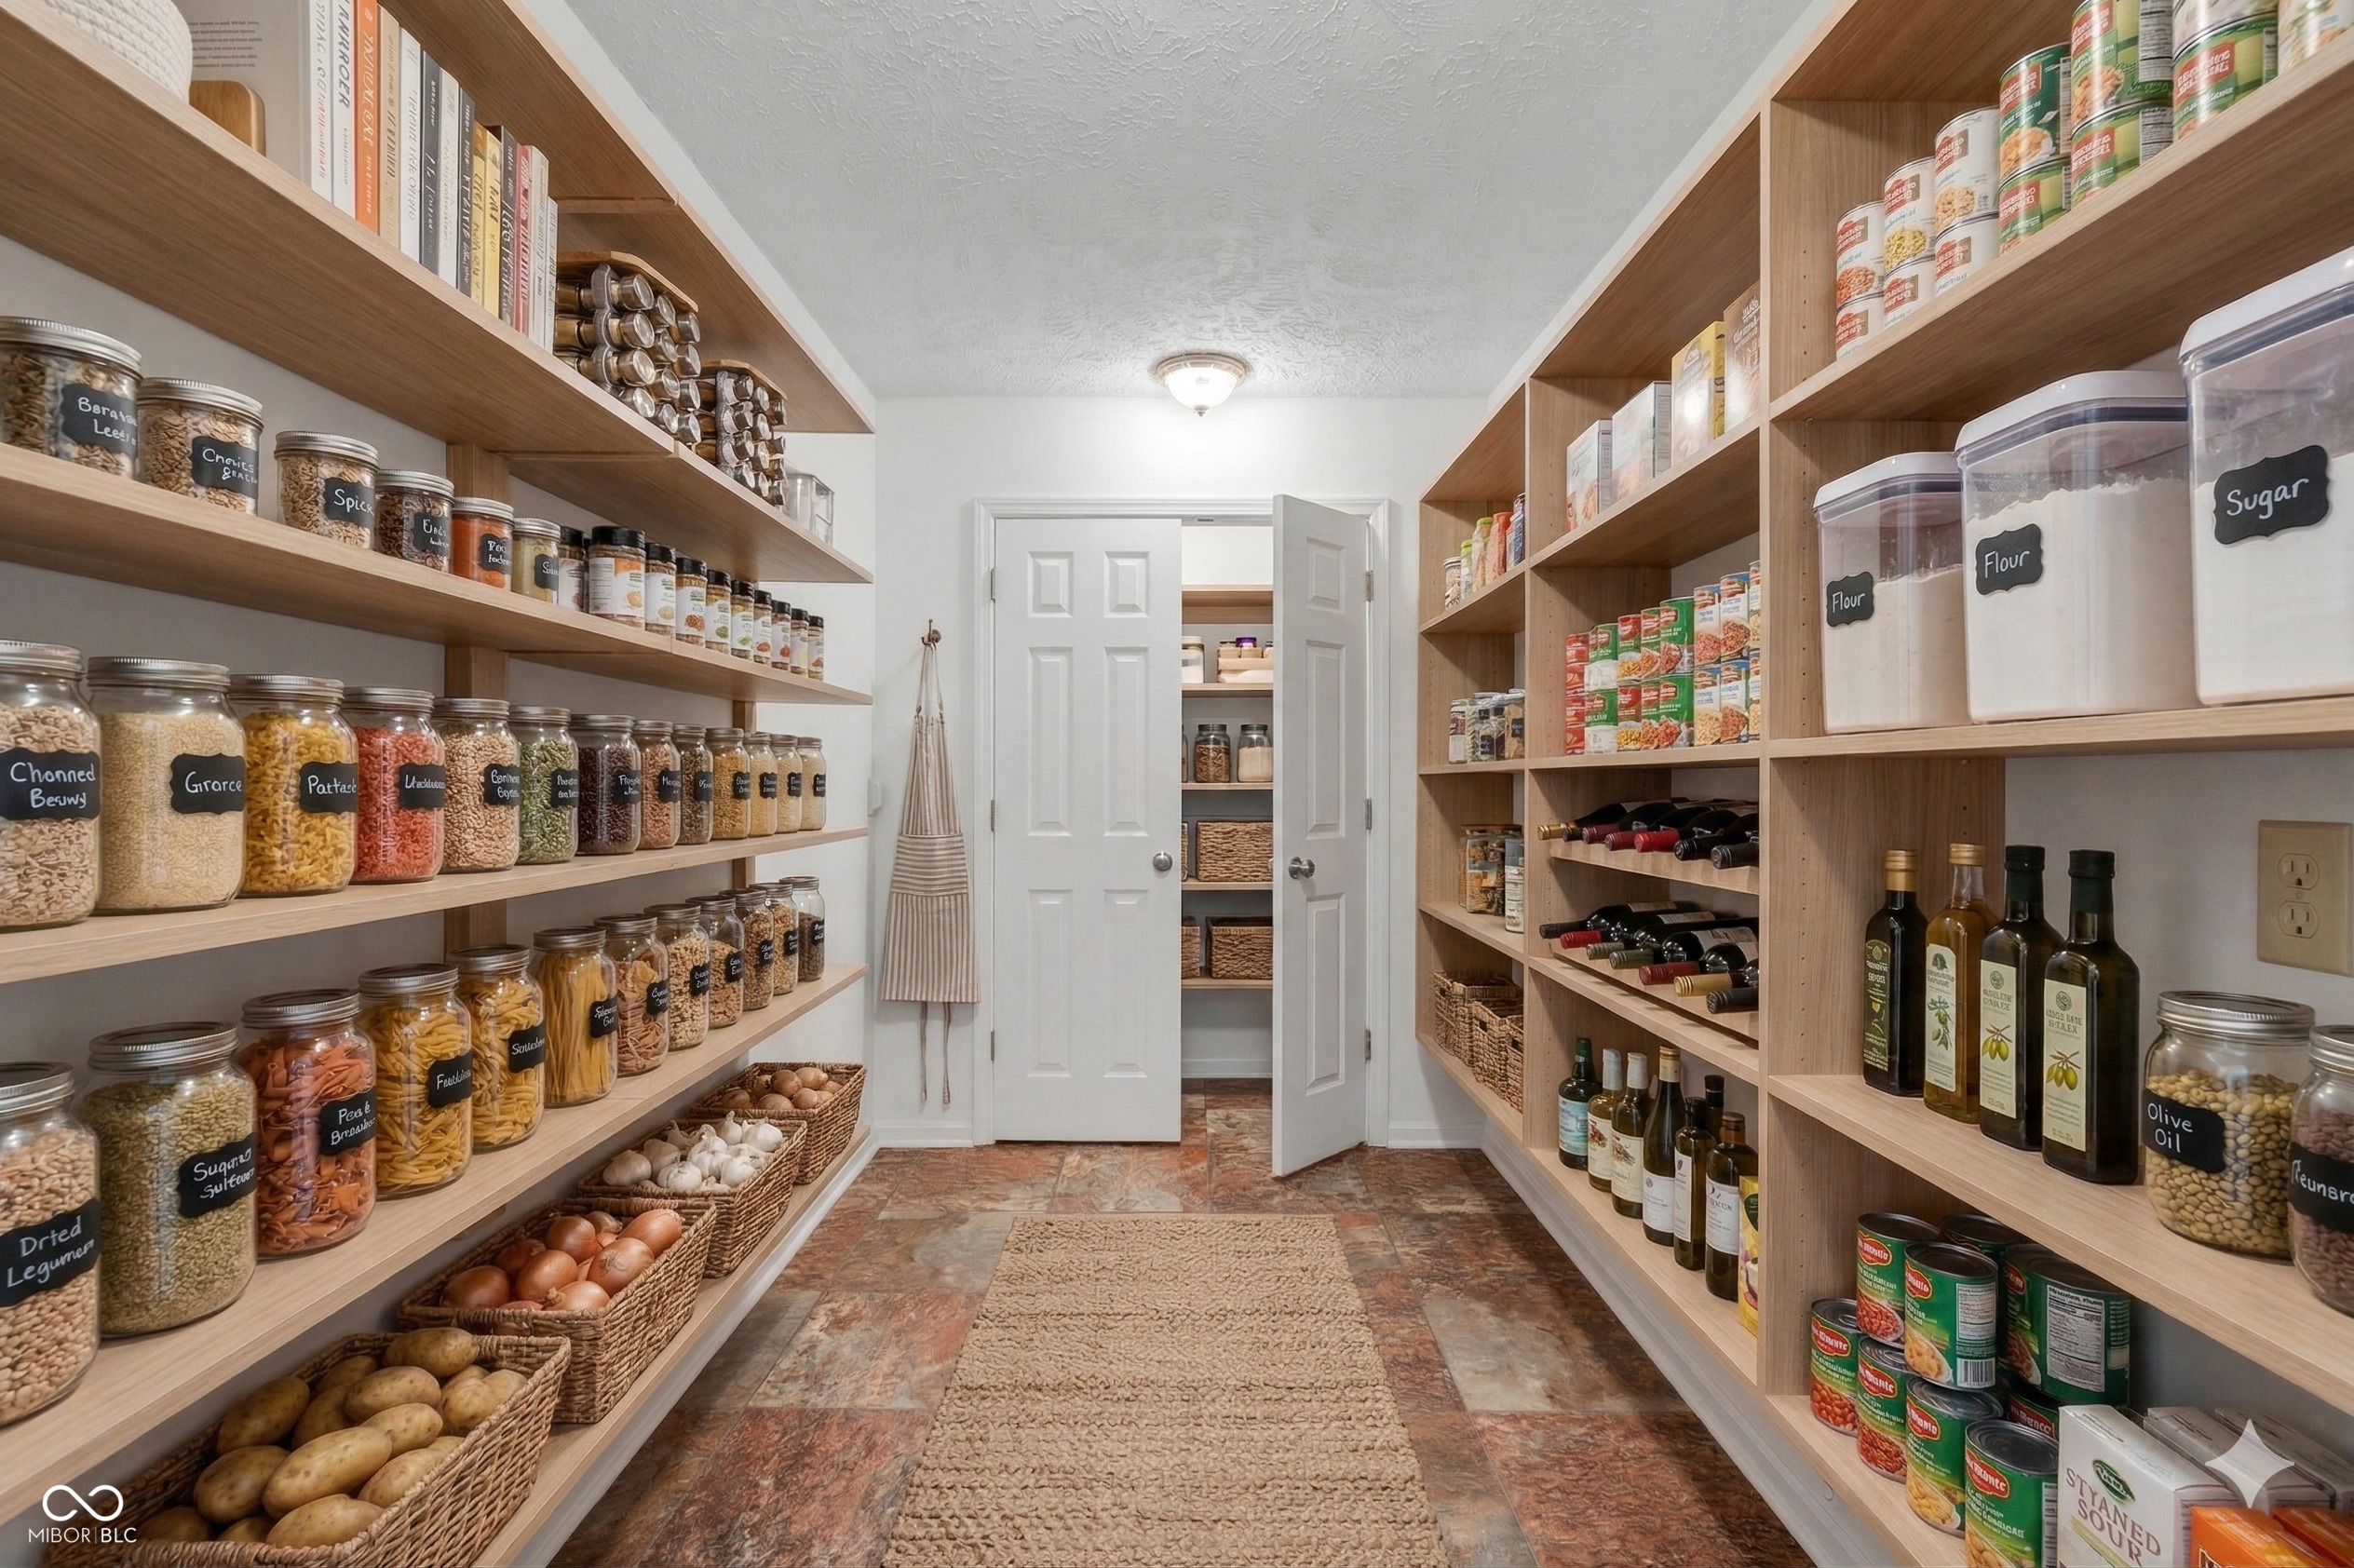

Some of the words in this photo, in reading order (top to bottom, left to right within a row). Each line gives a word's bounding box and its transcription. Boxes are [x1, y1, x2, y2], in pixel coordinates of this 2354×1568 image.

[2226, 478, 2309, 520] Sugar
[1984, 549, 2031, 579] Flour
[1832, 590, 1866, 614] Flour
[2147, 1102, 2194, 1133] Olive
[2155, 1128, 2182, 1154] Oil
[2065, 1467, 2161, 1557] STYANED
[2077, 1497, 2143, 1568] SOUR
